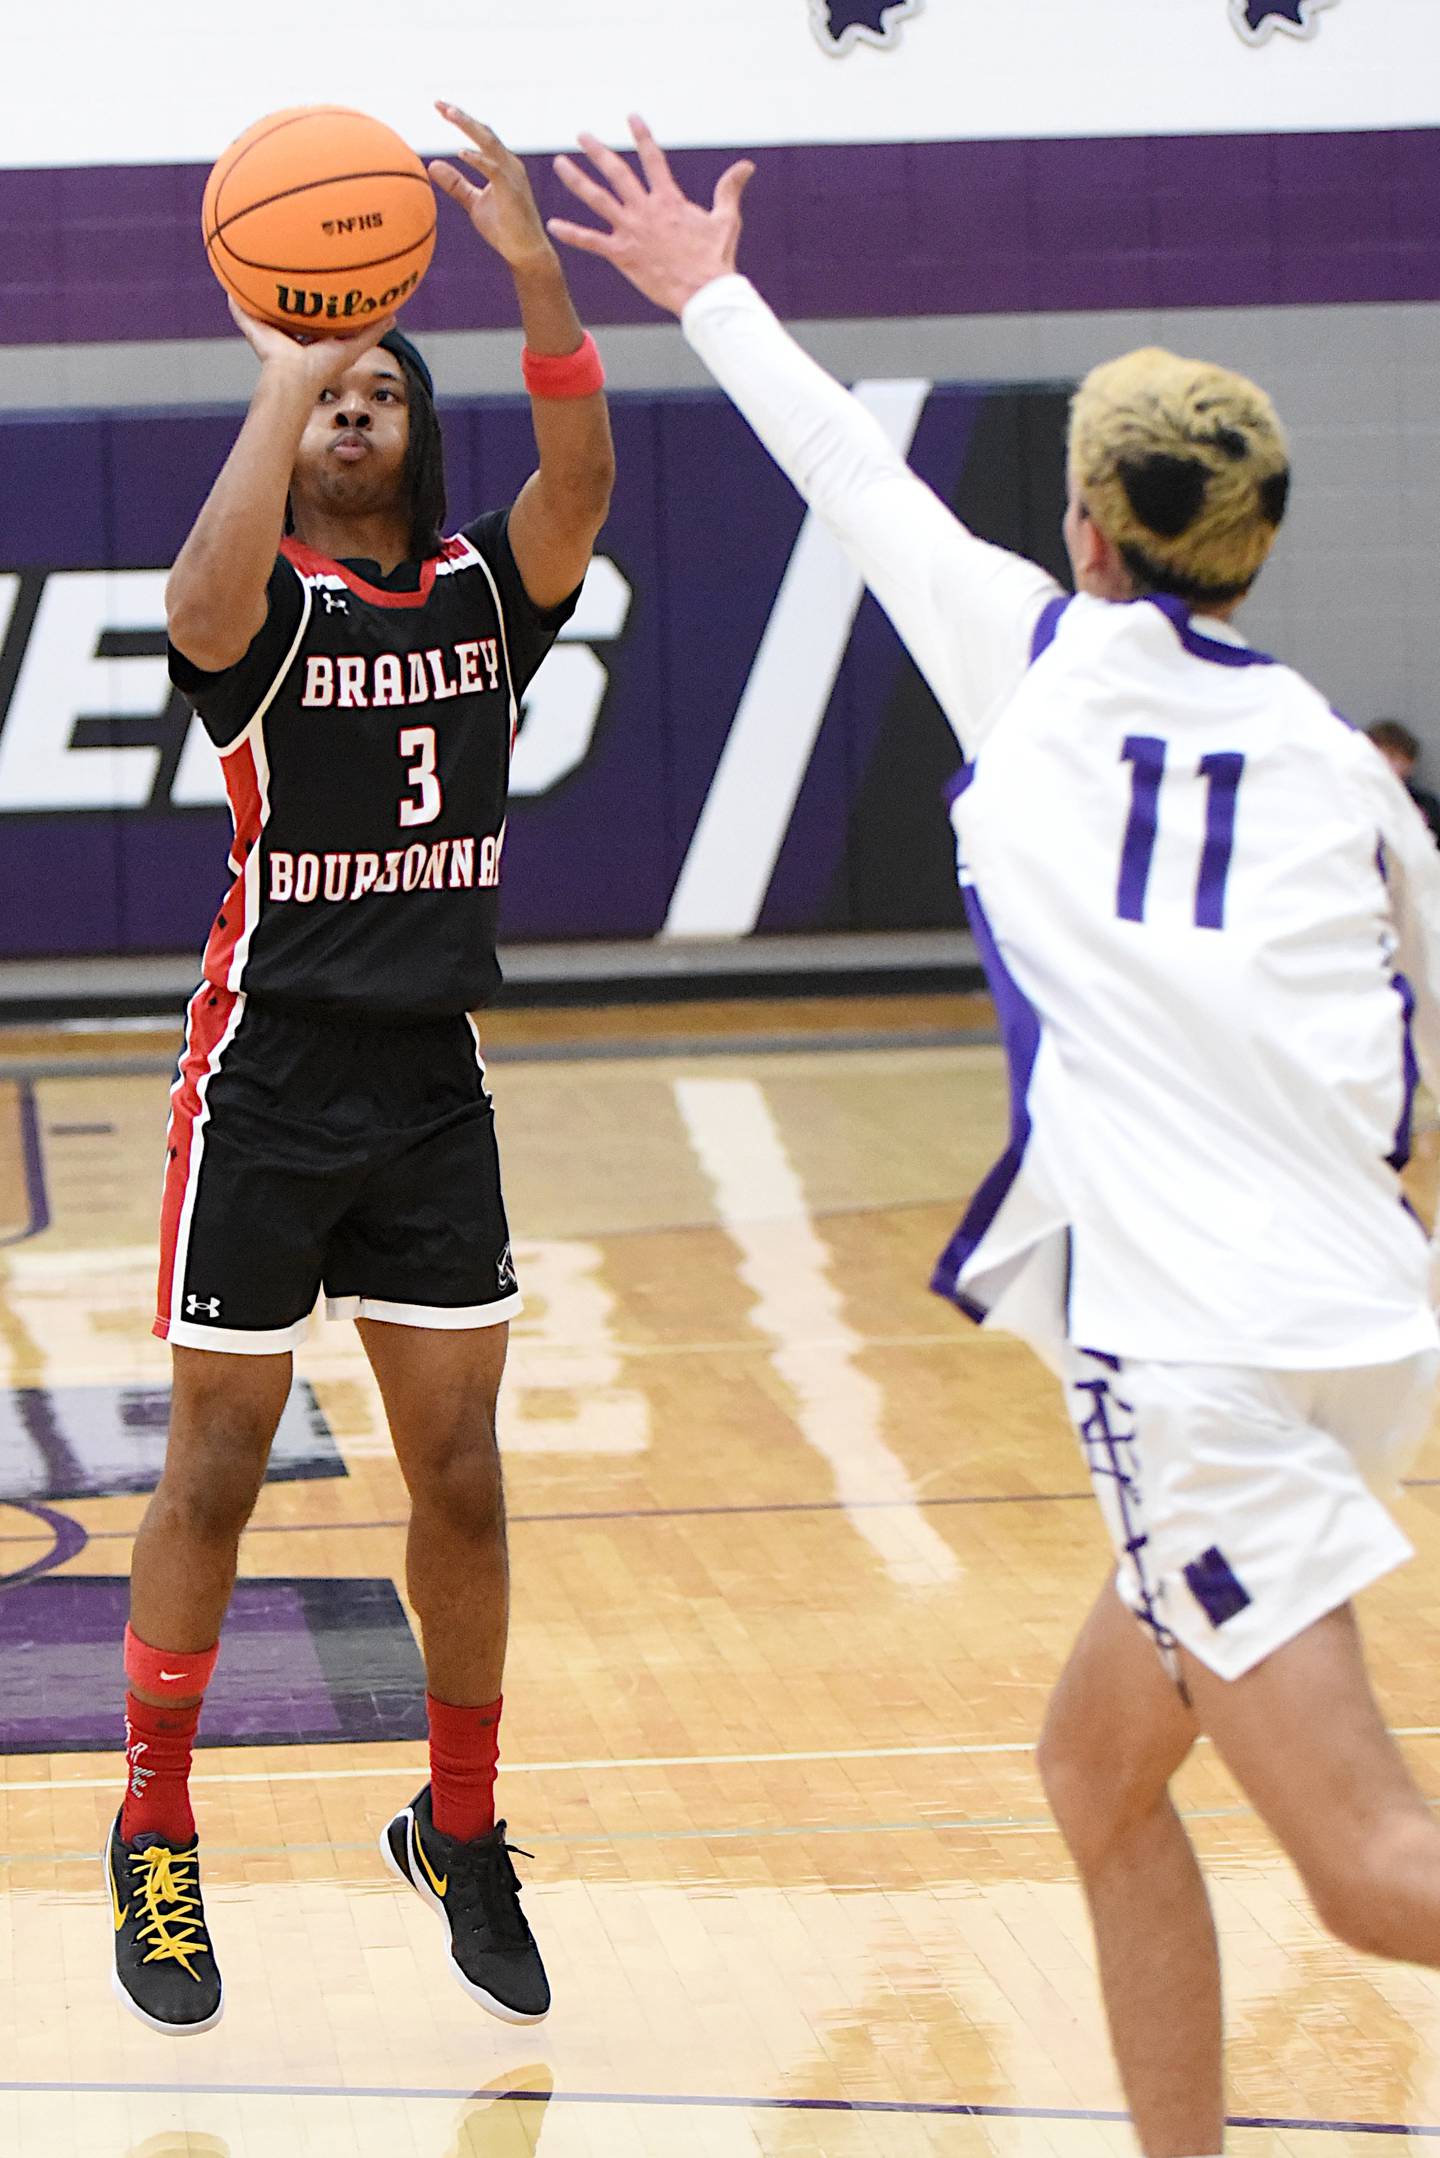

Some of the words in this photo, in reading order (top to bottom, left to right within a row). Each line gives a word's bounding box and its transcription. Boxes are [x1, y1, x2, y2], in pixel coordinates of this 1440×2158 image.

[275, 270, 419, 320] Wilson
[300, 637, 500, 708] BRADLEY
[398, 725, 442, 829] 3
[1115, 734, 1246, 931] 11
